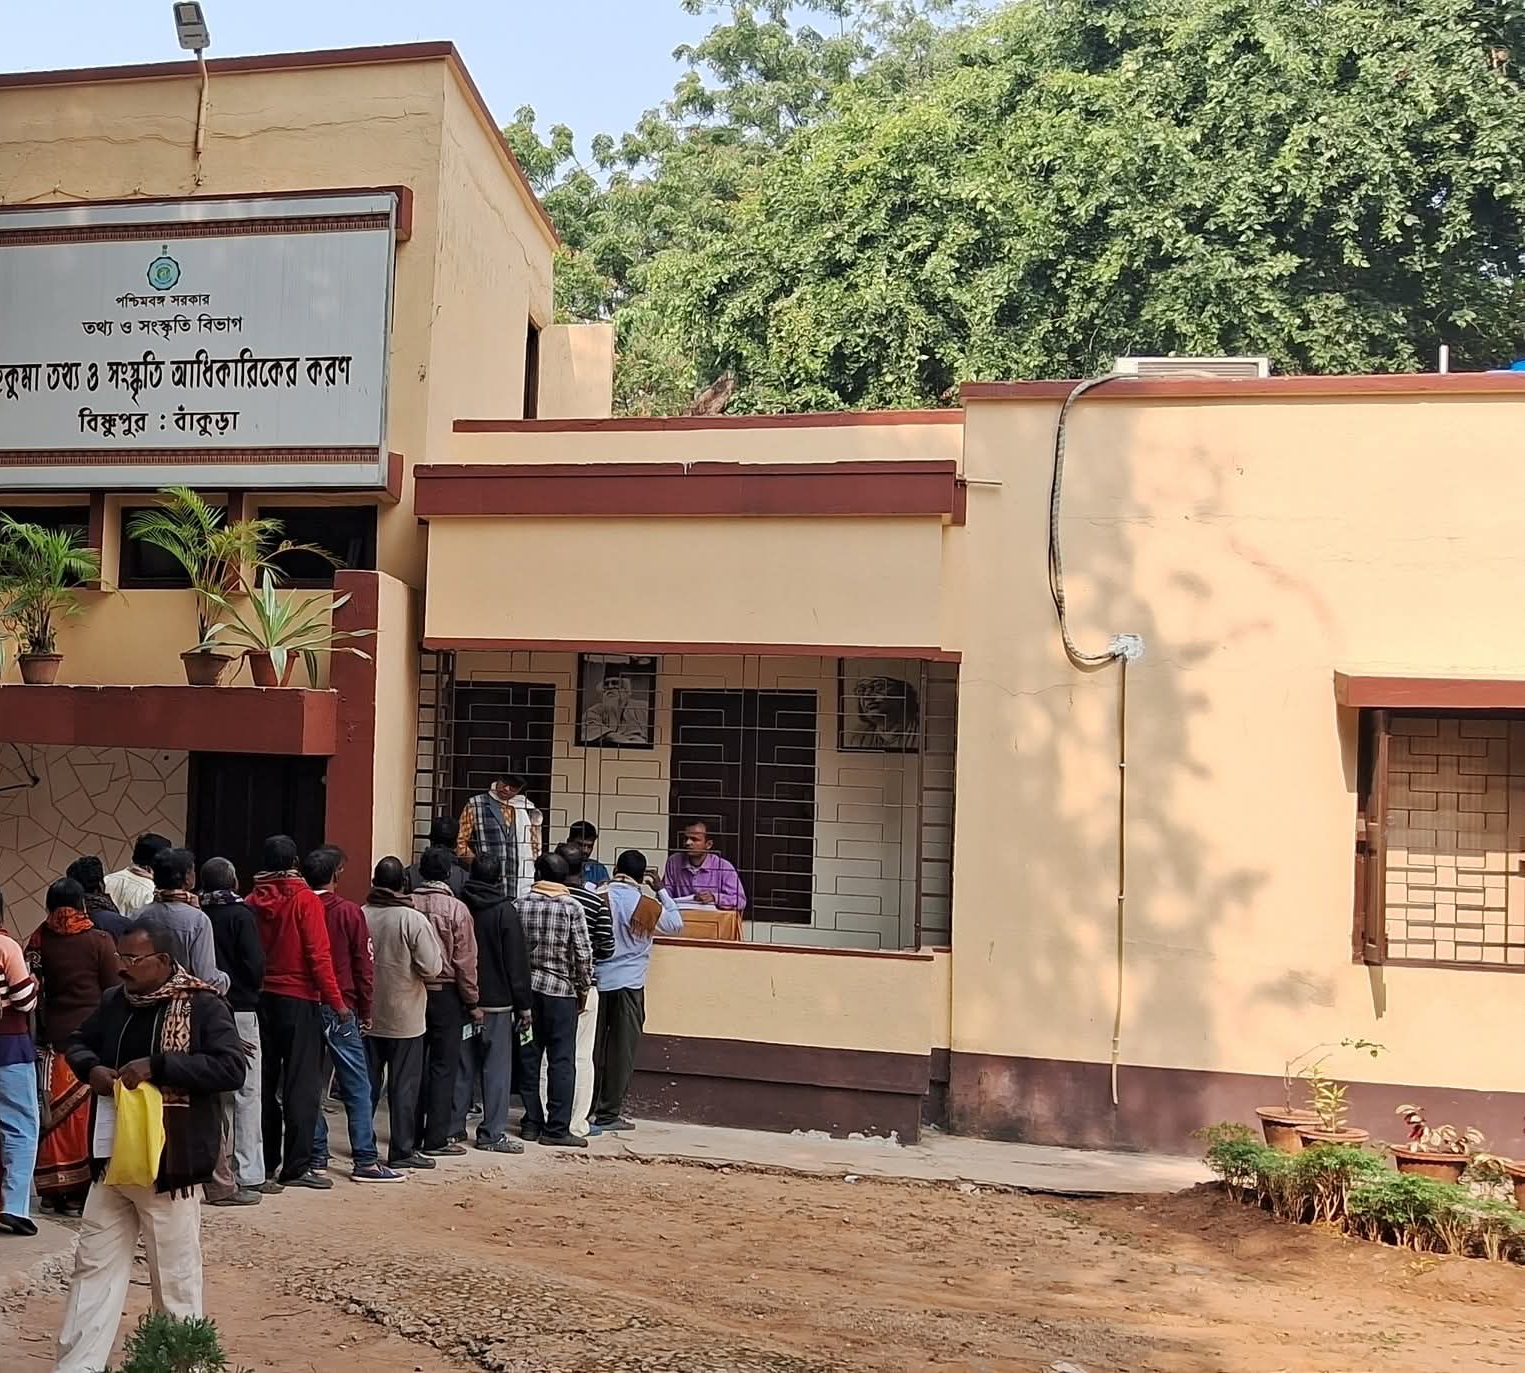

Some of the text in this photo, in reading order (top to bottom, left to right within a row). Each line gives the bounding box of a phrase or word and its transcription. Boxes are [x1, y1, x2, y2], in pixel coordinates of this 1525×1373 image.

[115, 293, 211, 309] পশ্চিমবঙ্গ সরকার
[82, 313, 243, 341] তথ্য ও সংস্কৃতি বিভাগ
[46, 362, 81, 392] তথ্য
[86, 363, 99, 392] ও
[106, 350, 165, 406] সংস্কৃতি
[170, 348, 301, 391] আধিকারিকের
[305, 355, 353, 388] করণ
[78, 407, 149, 439] বিষ্ণুপুর
[172, 404, 241, 438] বাঁকুড়া
